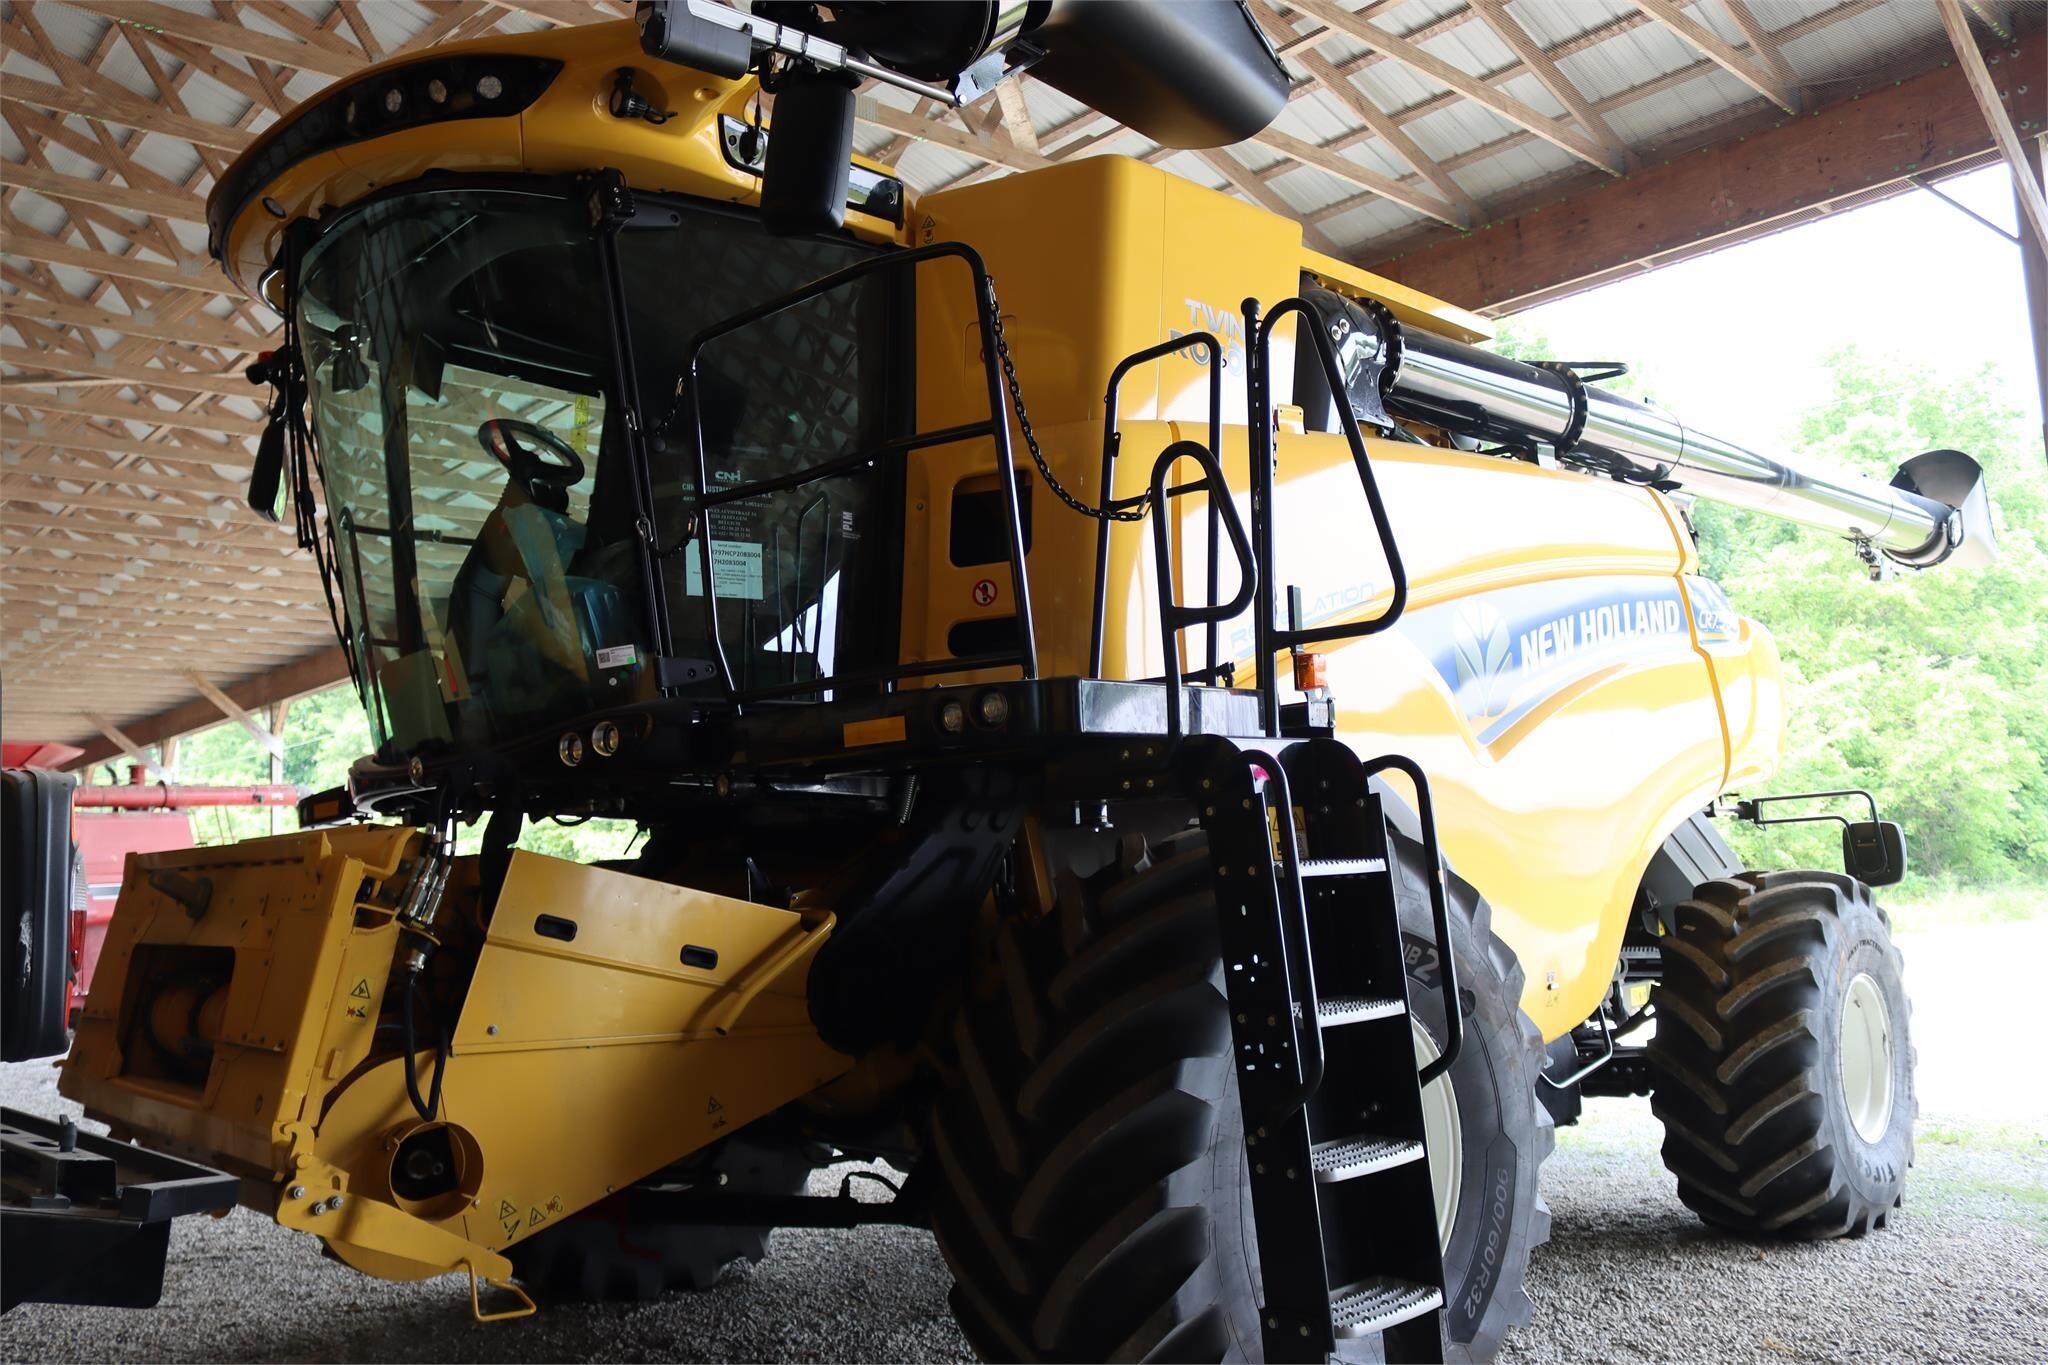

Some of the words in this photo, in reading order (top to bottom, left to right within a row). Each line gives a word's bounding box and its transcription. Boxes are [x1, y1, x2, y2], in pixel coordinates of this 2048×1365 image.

[1184, 298, 1246, 342] TWIN
[842, 511, 853, 532] PLM
[1520, 620, 1576, 677] NEW
[1581, 599, 1681, 649] HOLLAND
[1465, 1168, 1509, 1322] 900/60R32
